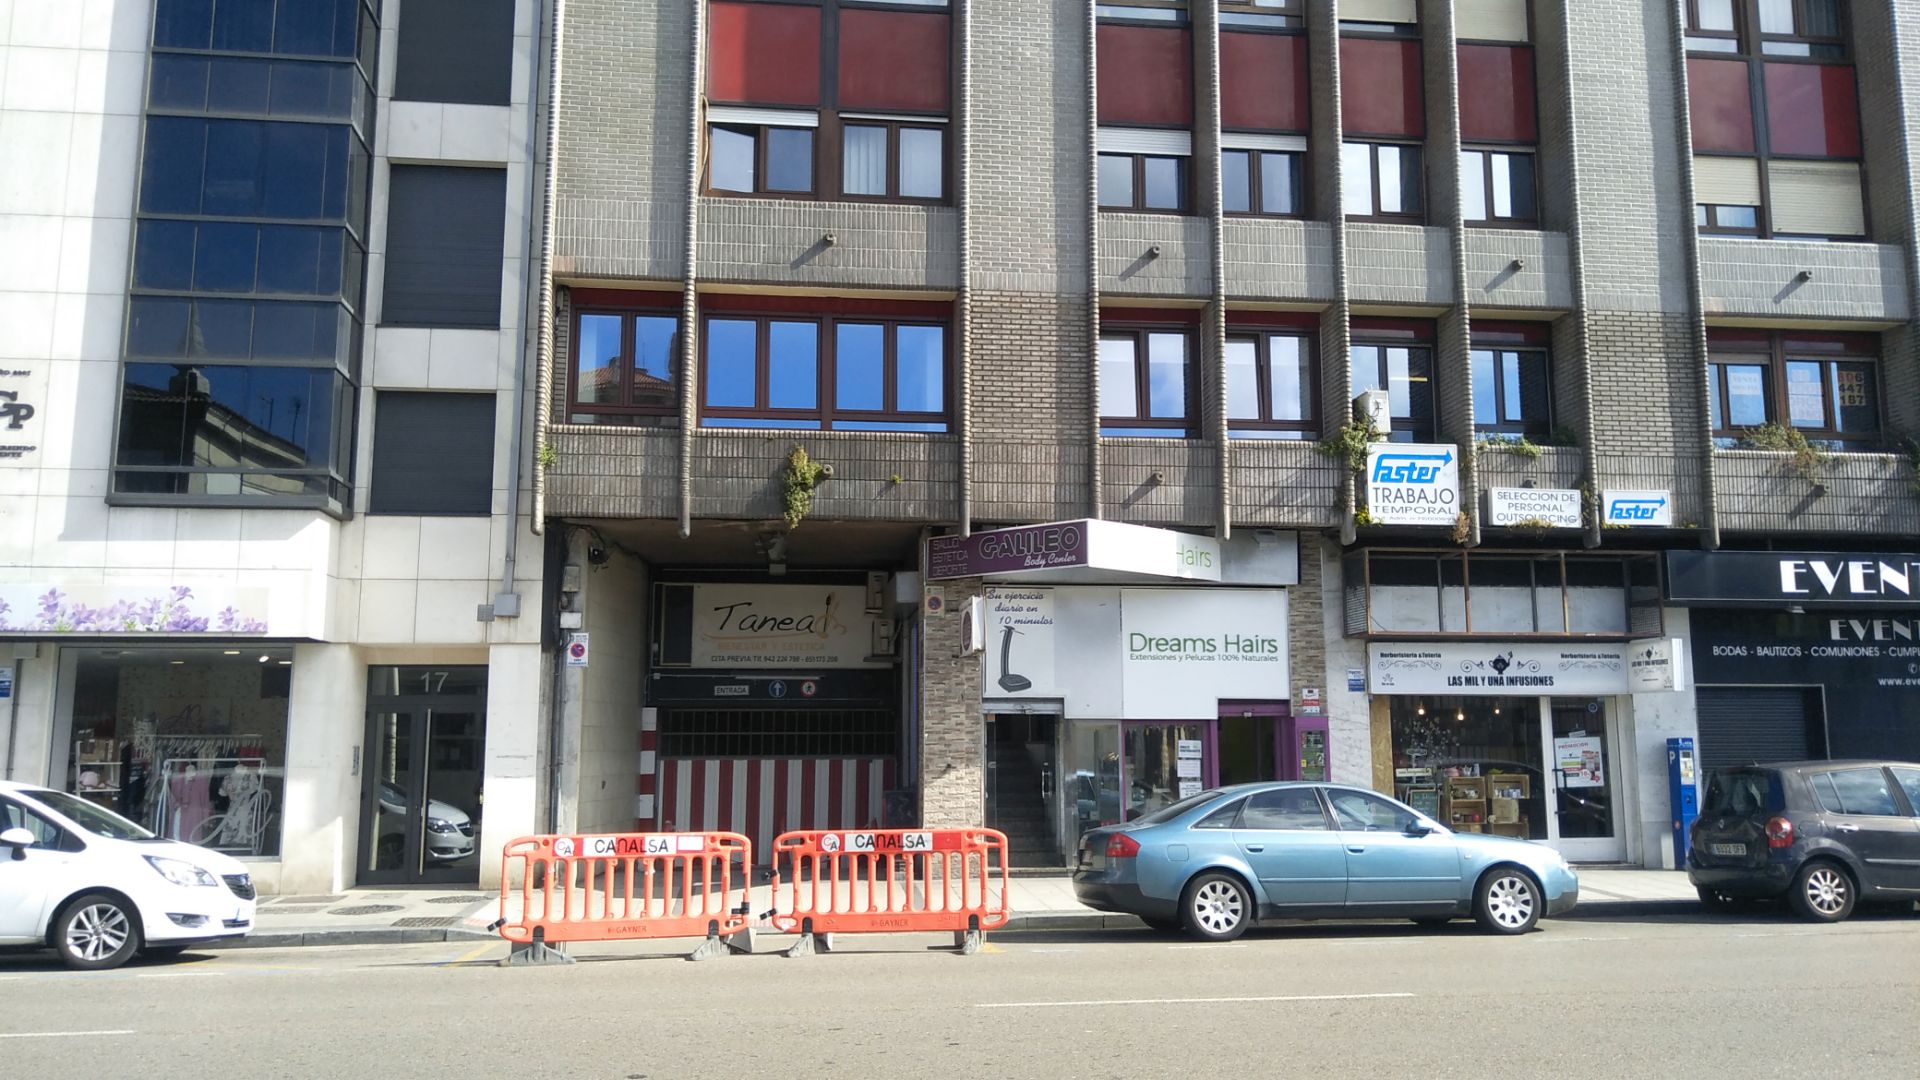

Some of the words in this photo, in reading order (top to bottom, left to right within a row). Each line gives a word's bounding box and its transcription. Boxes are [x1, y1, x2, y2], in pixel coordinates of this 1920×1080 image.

[1840, 395, 1864, 405] 187
[1373, 487, 1454, 504] TRABAJO
[1497, 491, 1558, 501] SELECCION
[1561, 493, 1576, 502] DE
[1373, 505, 1455, 515] TEMPORAL
[1508, 503, 1565, 512] PERSONAL
[1496, 512, 1577, 524] OUTSOURCING
[978, 525, 1080, 560] GALILEO
[932, 550, 968, 563] ESTETICA
[1024, 555, 1046, 568] Body
[1047, 552, 1077, 564] Center
[932, 563, 968, 576] DEPORTE
[988, 588, 1002, 600] Su
[1004, 591, 1044, 602] ejercicio
[995, 602, 1023, 612] diario
[714, 602, 815, 633] Tanea
[999, 616, 1012, 625] 10
[1014, 615, 1053, 625] minutos
[1130, 632, 1217, 653] Dreams
[1224, 633, 1278, 653] Hairs
[1130, 653, 1177, 661] Extensiones
[1185, 653, 1215, 661] Pelucas
[1217, 654, 1240, 662] 100%
[1241, 654, 1279, 662] Naturales
[1713, 646, 1747, 656] BODAS
[1757, 646, 1802, 656] BAUTIZOS
[1811, 646, 1880, 657] COMUNIONES
[420, 672, 449, 692] 17
[1447, 676, 1463, 687] LAS
[1464, 676, 1479, 687] MIL
[1480, 676, 1486, 686] Y
[1487, 676, 1505, 687] UNA
[1506, 676, 1554, 687] INFUSIONES
[716, 686, 747, 694] ENTRADA
[1669, 750, 1676, 765] P
[594, 838, 669, 853] CANALSA
[854, 833, 926, 849] CANALSA
